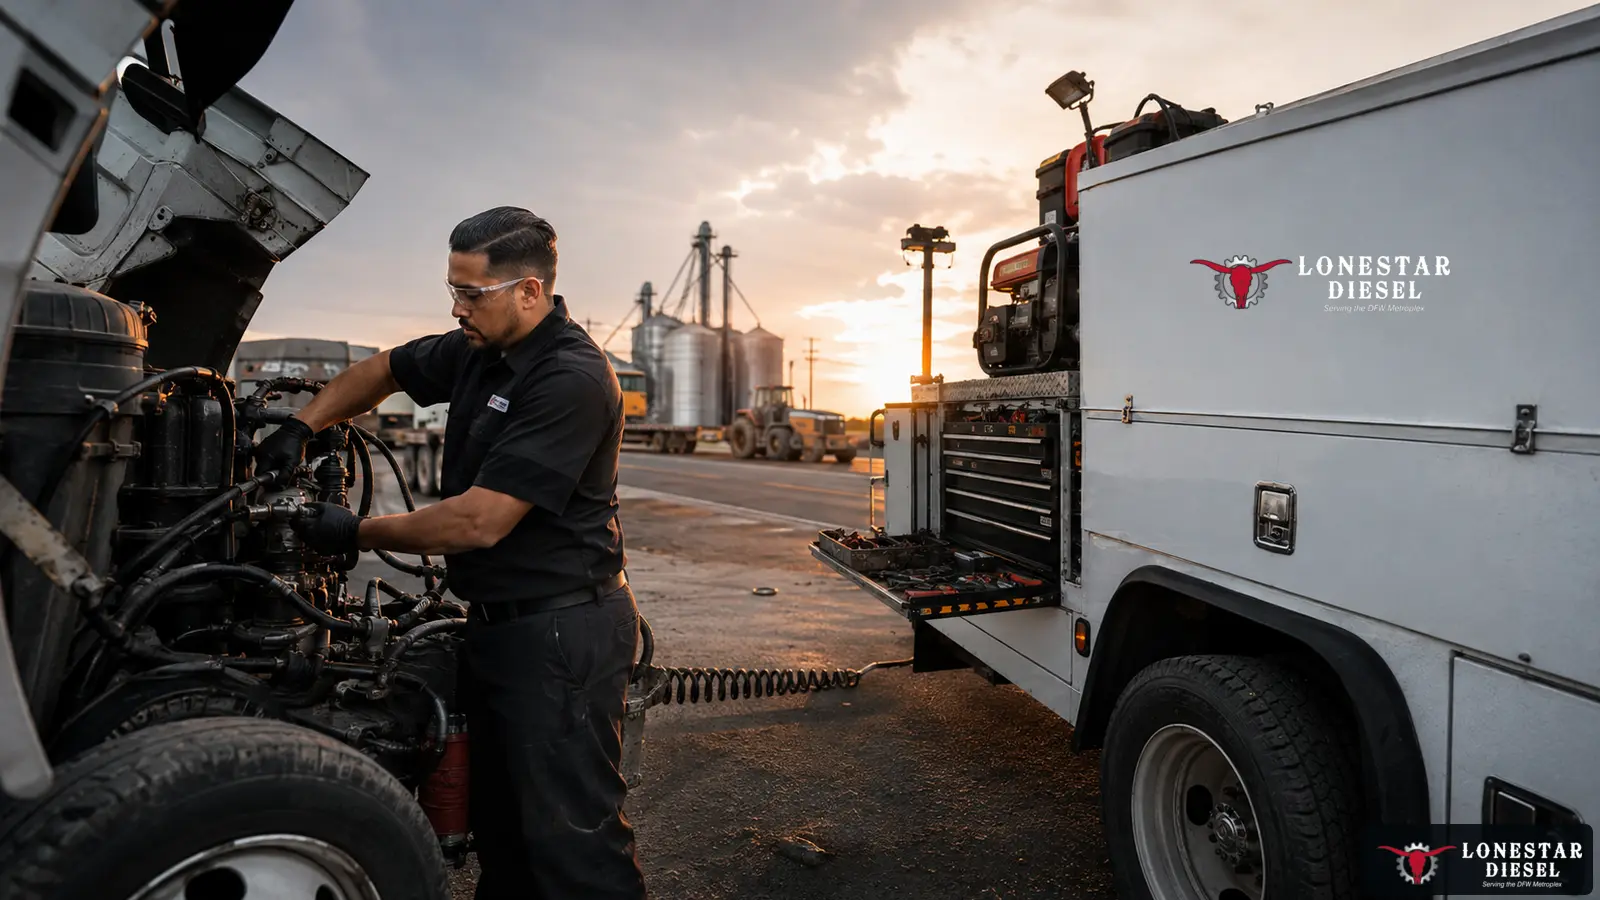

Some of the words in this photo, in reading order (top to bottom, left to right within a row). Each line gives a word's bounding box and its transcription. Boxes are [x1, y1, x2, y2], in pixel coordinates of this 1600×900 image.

[1298, 255, 1451, 276] LONESTAR
[1327, 280, 1422, 300] DIESEL
[1323, 304, 1352, 313] Serving
[1353, 304, 1366, 312] the
[1367, 304, 1386, 312] DFW
[1387, 304, 1425, 313] Metroplex
